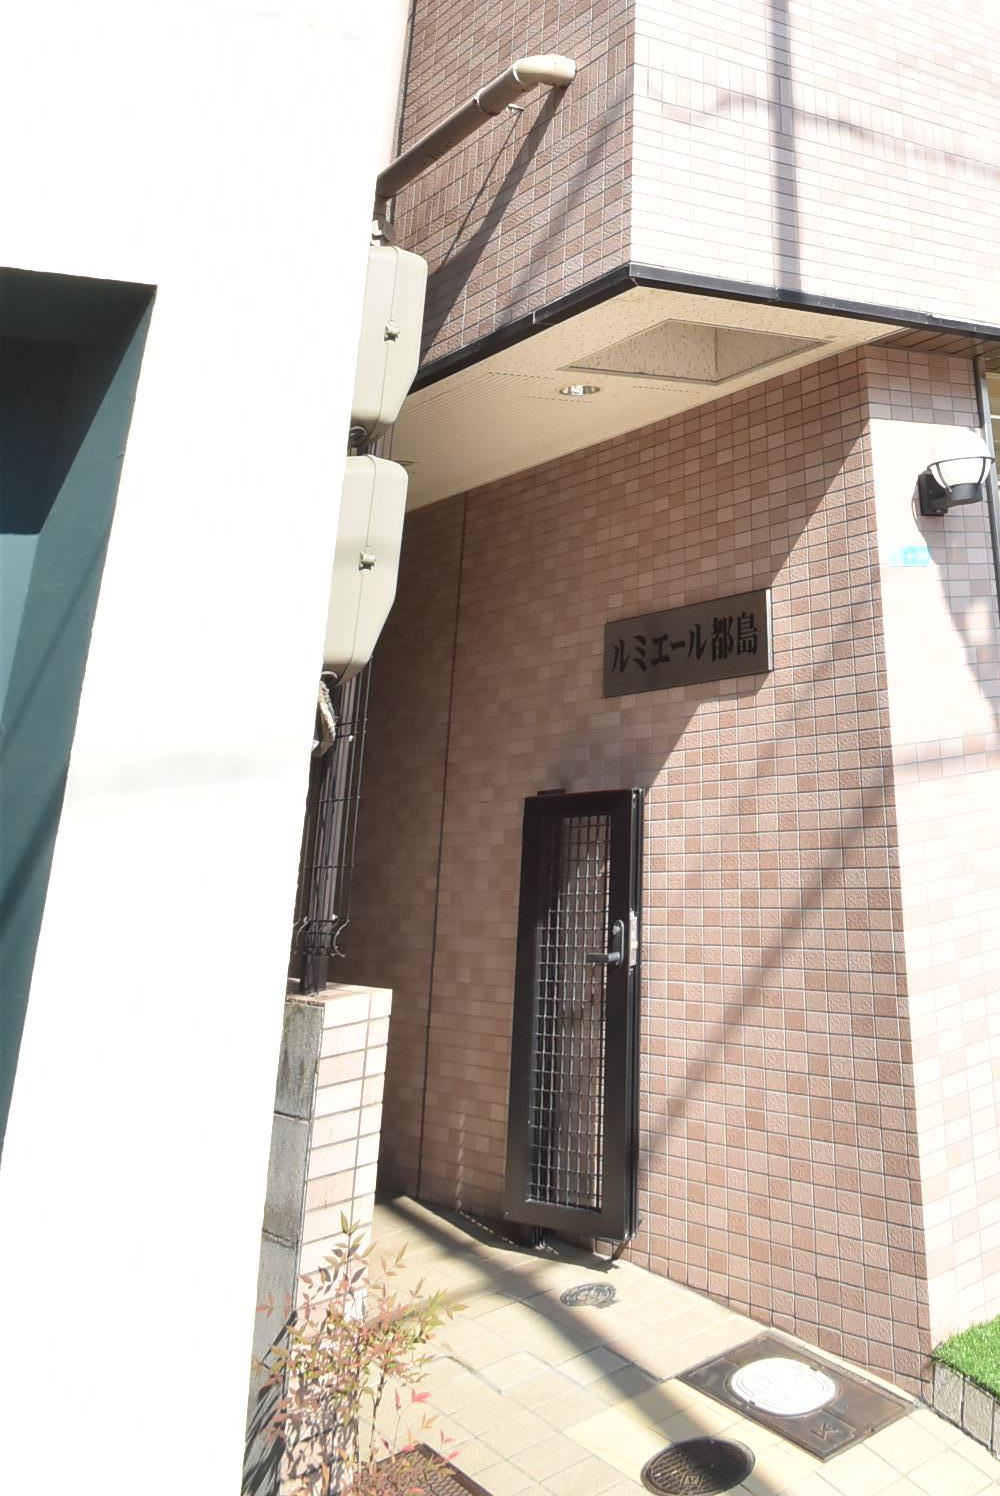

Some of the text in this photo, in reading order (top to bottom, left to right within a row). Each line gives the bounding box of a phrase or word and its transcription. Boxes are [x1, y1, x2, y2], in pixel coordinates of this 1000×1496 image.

[611, 611, 758, 674] ルミエール都島
